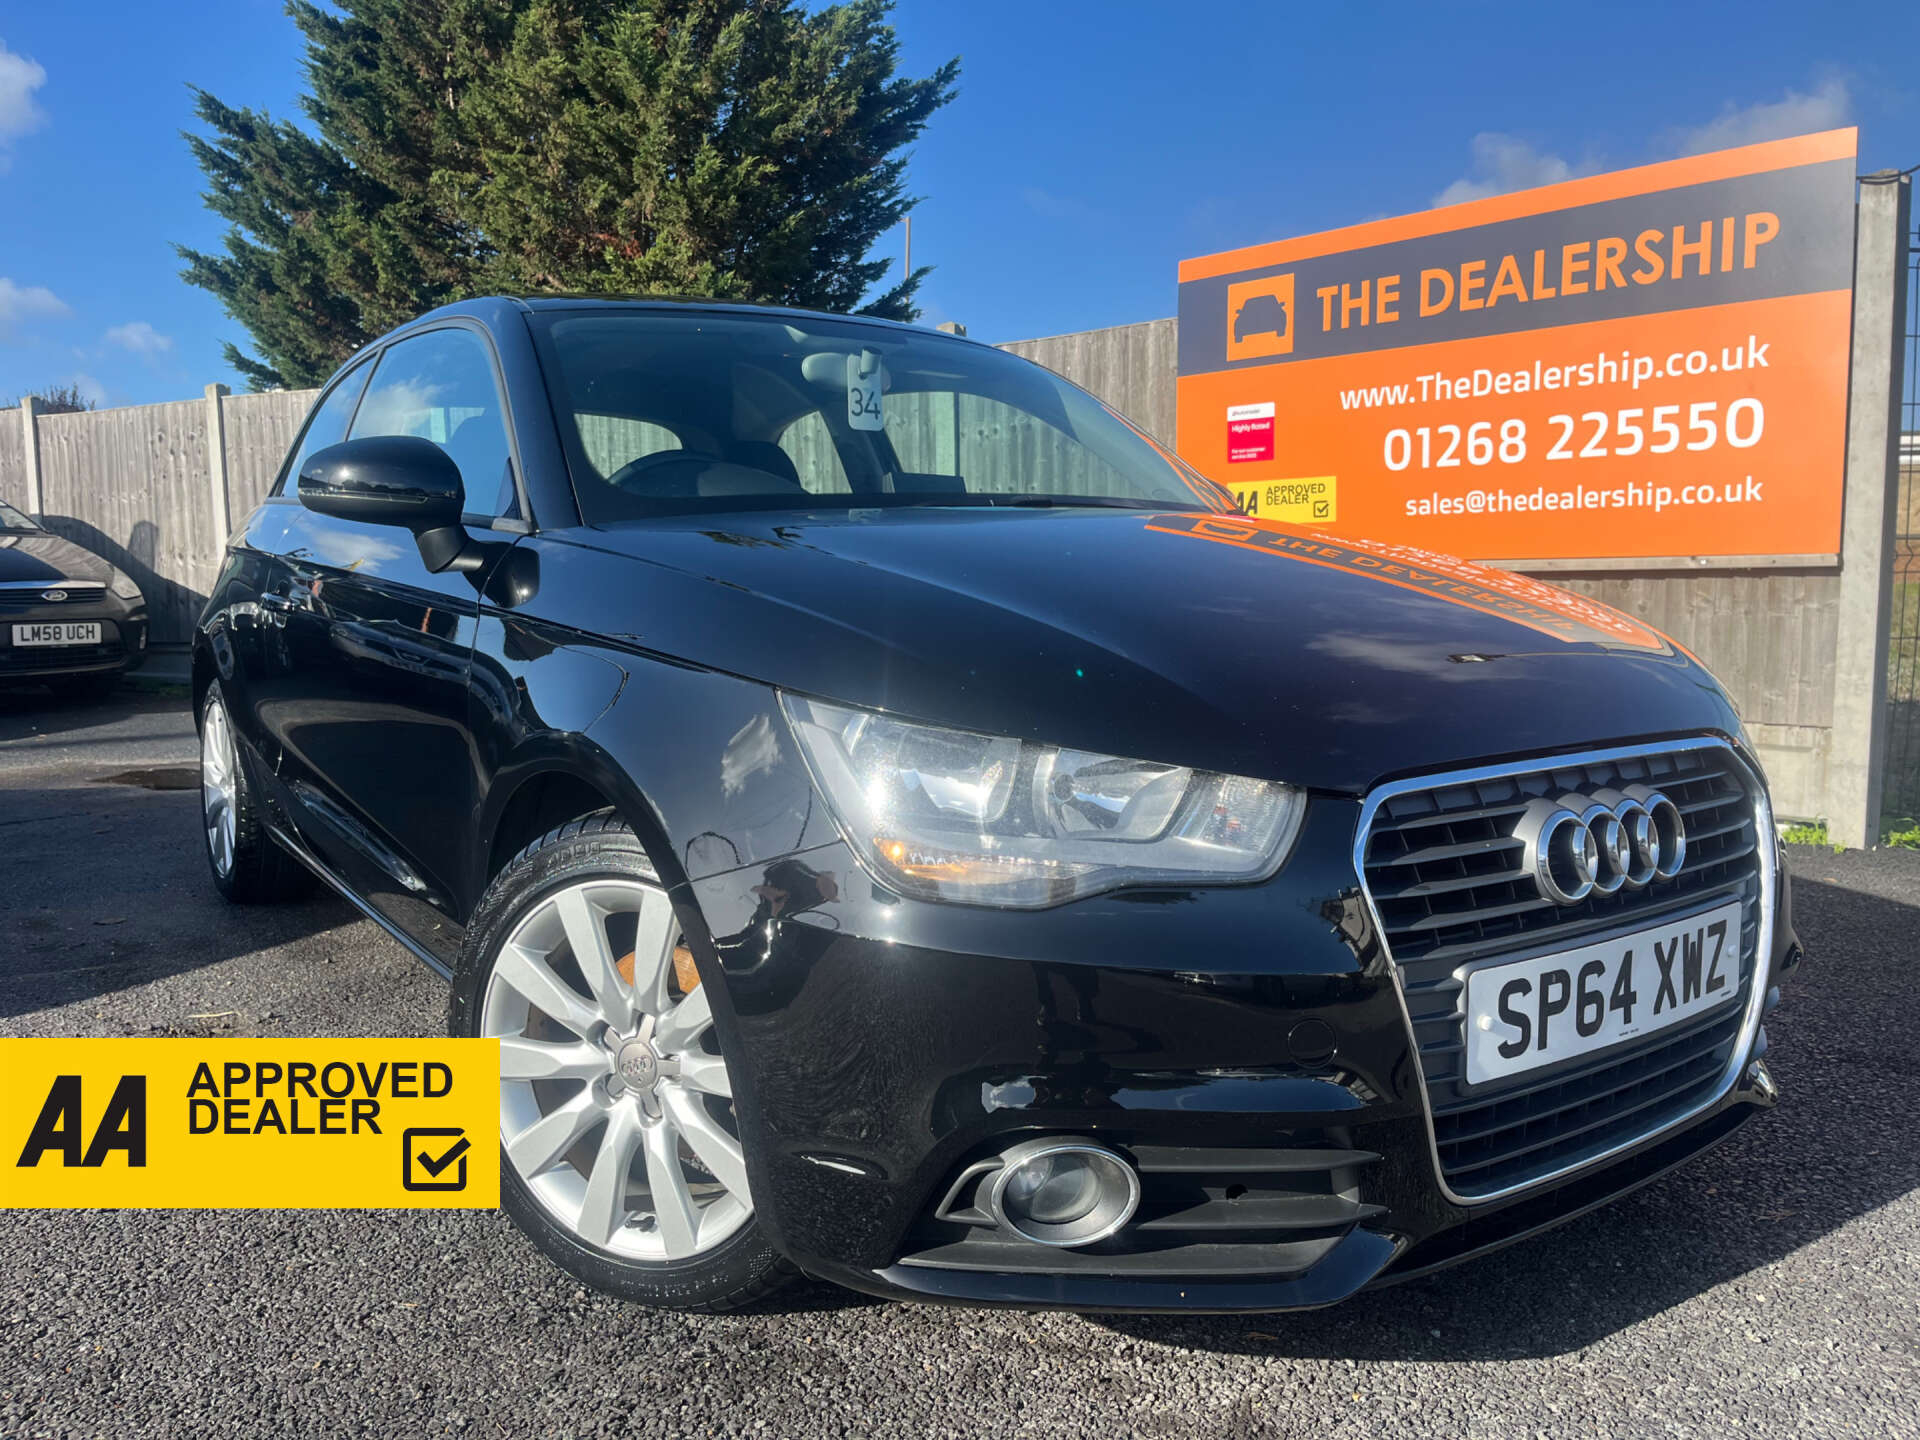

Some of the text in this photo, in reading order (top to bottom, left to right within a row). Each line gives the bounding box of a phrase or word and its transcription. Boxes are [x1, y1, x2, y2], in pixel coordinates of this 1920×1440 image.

[1316, 211, 1781, 332] THE DEALERSHIP
[1339, 335, 1770, 411] www.TheDealership.co.uk
[850, 387, 881, 420] 34
[1383, 397, 1765, 472] 01268 225550
[1266, 483, 1326, 497] APPROVED
[1266, 494, 1309, 506] DEALER
[1405, 475, 1764, 517] sales@thedealership.co.uk
[20, 624, 95, 642] LM58 UCH
[1497, 919, 1728, 1060] SP64 XWZ
